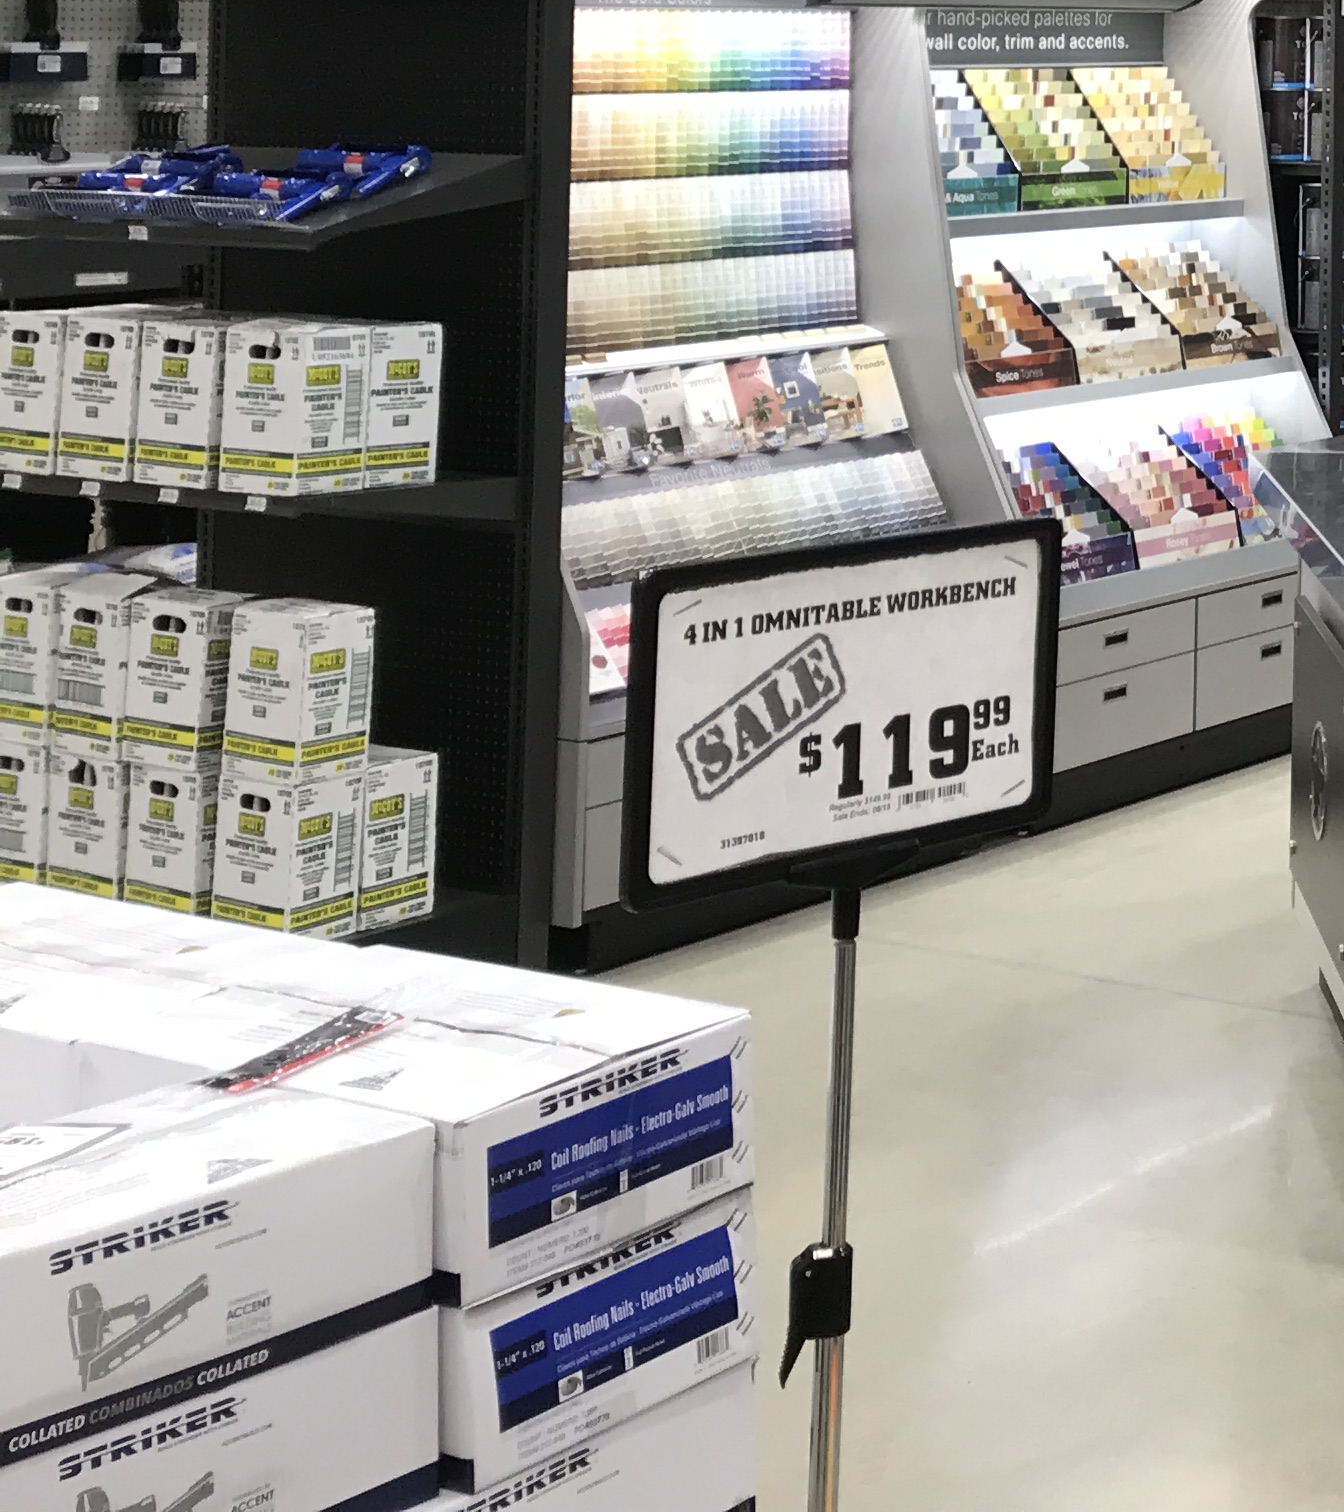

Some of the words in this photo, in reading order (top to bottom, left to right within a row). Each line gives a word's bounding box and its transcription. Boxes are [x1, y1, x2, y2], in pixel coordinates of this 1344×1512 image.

[936, 9, 1031, 28] hand-picked
[1034, 9, 1091, 29] palettes
[1094, 10, 1113, 27] for
[926, 33, 953, 51] wall
[958, 34, 1000, 53] color,
[1004, 34, 1034, 50] trim
[1038, 33, 1065, 50] and
[1069, 34, 1129, 50] accents.
[953, 193, 974, 205] Aqua
[1052, 186, 1076, 198] Green
[736, 367, 765, 380] Warm
[854, 359, 886, 373] Trends
[995, 369, 1019, 383] Spice
[304, 393, 342, 402] PAINTER'S
[649, 467, 710, 488] Favorite
[712, 458, 770, 480] Neutrals
[1062, 558, 1079, 571] ewel
[684, 625, 697, 645] 4
[702, 619, 727, 644] IN
[734, 618, 745, 638] 1
[751, 595, 882, 636] OMNITABLE
[886, 576, 1017, 615] WORKBENCH
[308, 677, 347, 690] PAINTER'S
[315, 688, 339, 699] CAULK
[695, 647, 834, 785] SALE
[341, 738, 365, 750] CAULK
[971, 734, 1020, 763] Each
[829, 799, 863, 812] Regularly
[833, 813, 848, 822] Sale
[368, 822, 406, 837] PAINTER'S
[374, 832, 399, 845] CAULK
[296, 841, 333, 857] PAINTER'S
[303, 852, 325, 865] CAULK
[363, 888, 402, 904] PAINTER'S
[404, 880, 427, 895] CAULK
[290, 907, 328, 925] PAINTER'S
[330, 899, 352, 915] CAULK
[538, 1047, 688, 1118] STRIKER
[551, 1151, 570, 1171] Coil
[571, 1132, 608, 1163] Roofing
[610, 1123, 635, 1149] Nails
[641, 1098, 695, 1133] Electro-Galv
[696, 1084, 730, 1111] Smooth
[49, 1200, 240, 1276] STRIKER
[227, 1295, 272, 1320] ACCENT
[553, 1330, 572, 1351] Coil
[573, 1311, 610, 1343] Roofing
[611, 1300, 635, 1324] Nails
[640, 1275, 695, 1309] Electro-Galv
[696, 1256, 730, 1285] Smooth
[8, 1414, 86, 1453] COLLATED
[89, 1376, 195, 1425] COMBINADOS
[196, 1349, 269, 1386] COLLATED
[57, 1397, 247, 1481] STRIKER
[458, 1447, 599, 1512] TRIKER
[231, 1489, 275, 1512] ACCENT
